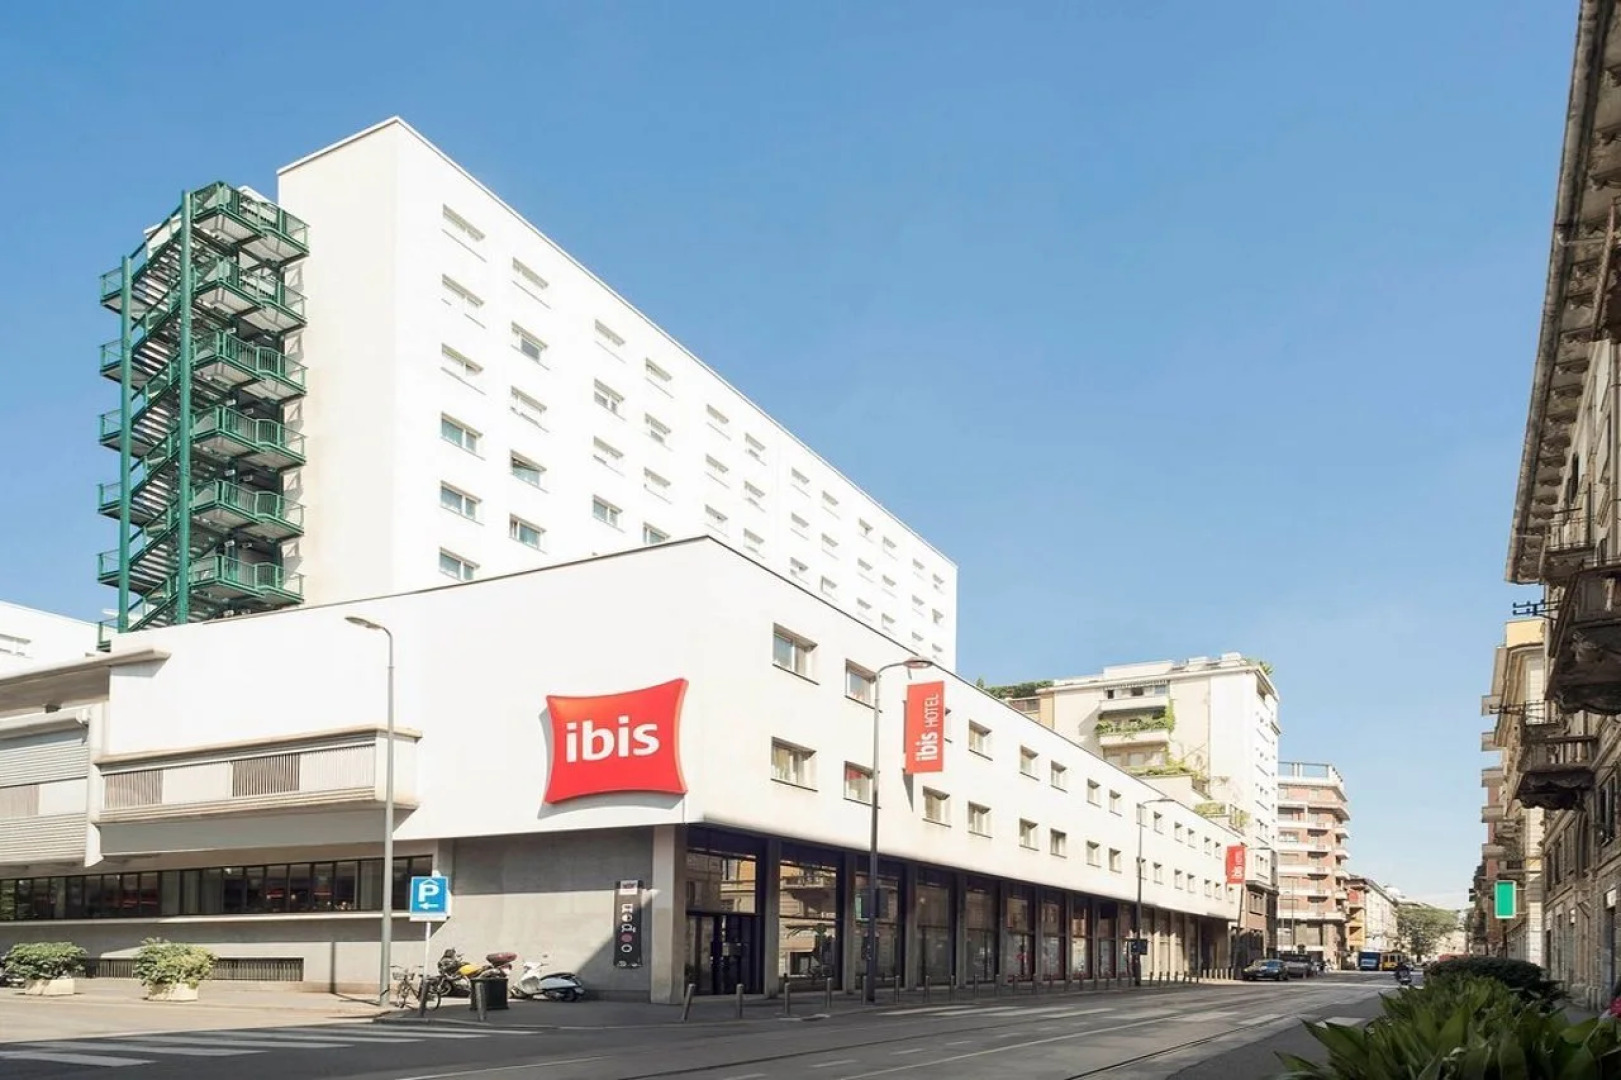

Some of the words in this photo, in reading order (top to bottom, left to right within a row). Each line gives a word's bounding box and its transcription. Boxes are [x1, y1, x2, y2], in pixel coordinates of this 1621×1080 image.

[923, 693, 940, 728] HOTEL
[565, 715, 660, 763] ibis
[915, 731, 938, 762] ibis
[418, 883, 440, 902] P
